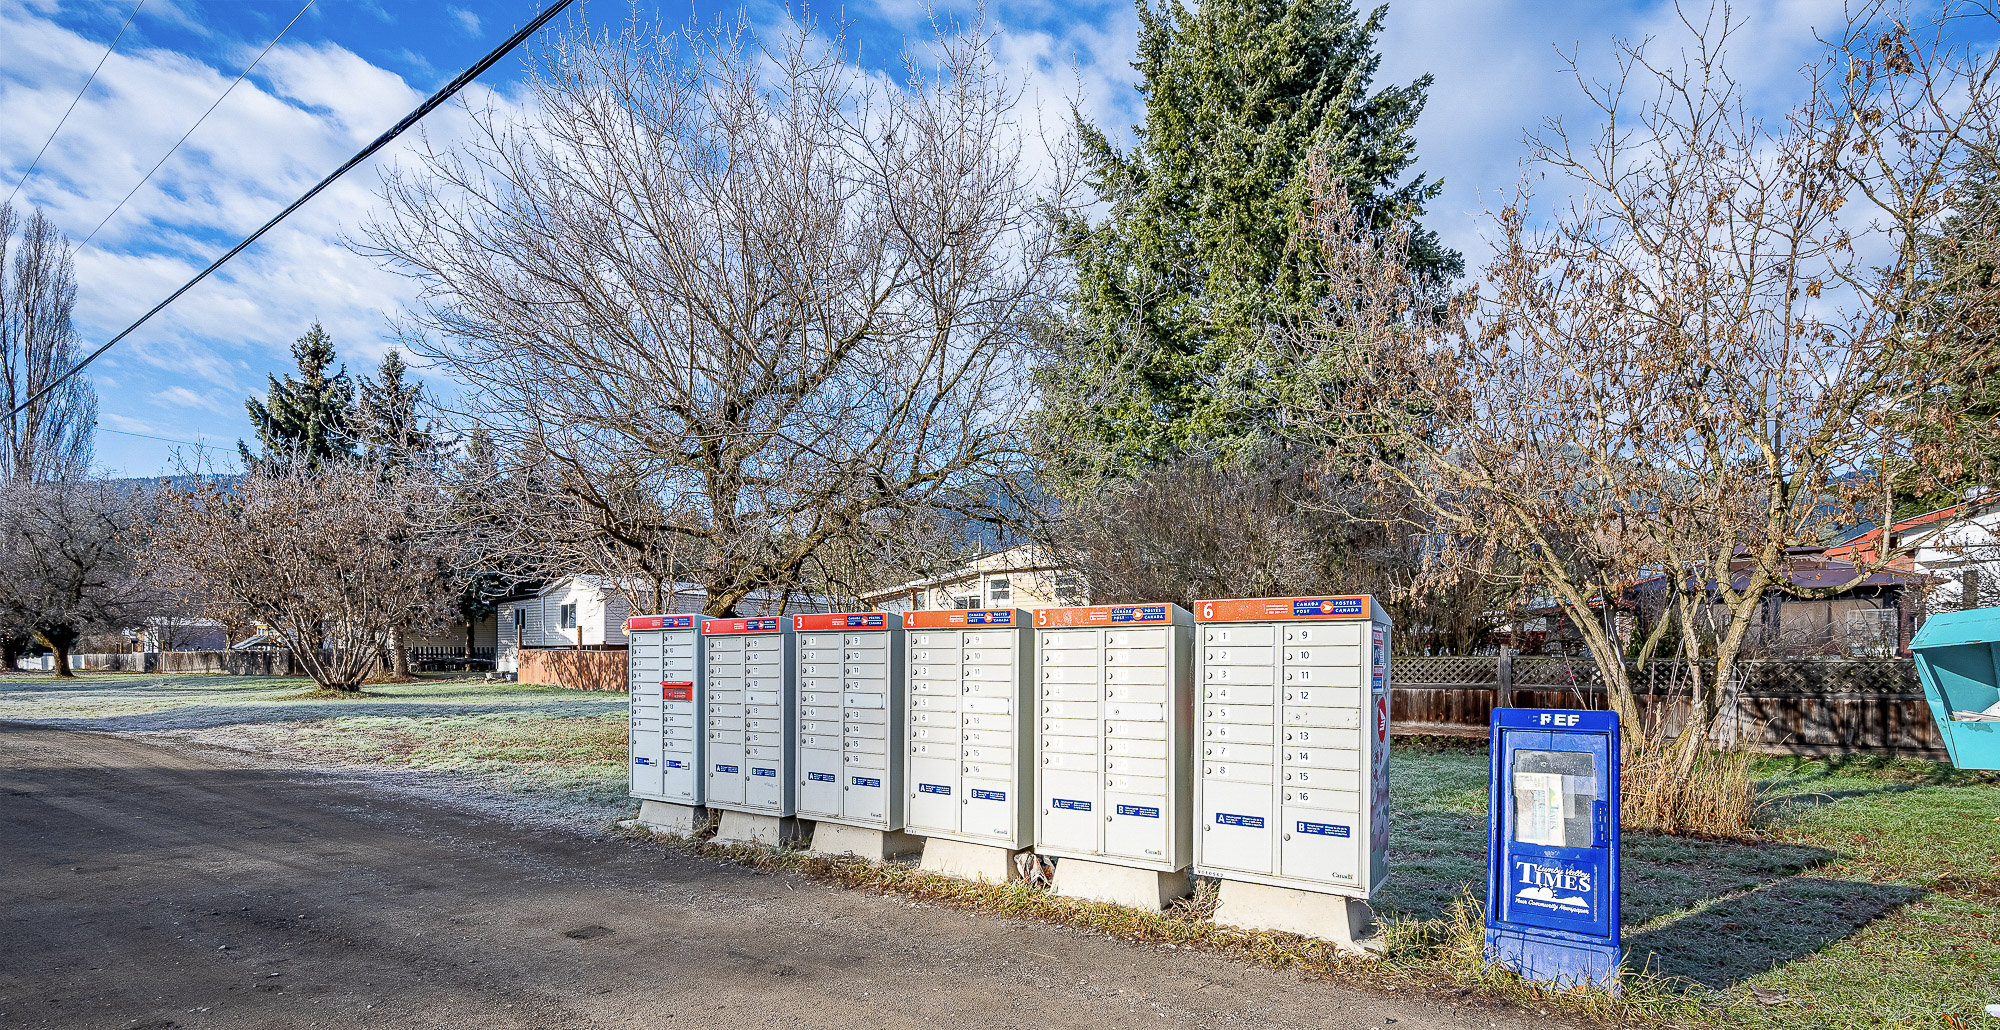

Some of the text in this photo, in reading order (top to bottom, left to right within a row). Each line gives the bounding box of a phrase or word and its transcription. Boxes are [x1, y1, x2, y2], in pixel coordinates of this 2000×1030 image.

[1203, 603, 1213, 619] 6
[907, 613, 914, 626] 4
[1039, 610, 1046, 625] 5
[629, 619, 633, 628] 1
[705, 622, 710, 632] 2
[797, 617, 802, 628] 3
[1222, 632, 1226, 640] 1
[1301, 631, 1308, 640] 9
[1221, 651, 1227, 659] 2
[1300, 650, 1310, 660] 10
[1221, 670, 1227, 678] 3
[1301, 671, 1309, 679] 11
[1220, 689, 1226, 697] 4
[1300, 691, 1309, 700] 12
[1220, 708, 1226, 717] 5
[1220, 727, 1226, 736] 6
[1299, 731, 1309, 741] 13
[1220, 747, 1226, 755] 7
[1299, 752, 1309, 761] 14
[1219, 766, 1226, 774] 8
[1299, 772, 1309, 781] 15
[1299, 792, 1309, 801] 16
[1054, 800, 1060, 808] A
[1118, 805, 1124, 814] B
[1218, 814, 1225, 823] A
[1298, 823, 1304, 831] B
[1516, 861, 1591, 892] TIMES
[1537, 865, 1590, 880] Lumby Valley
[1528, 900, 1559, 911] Community
[1559, 904, 1590, 914] Newspaper
